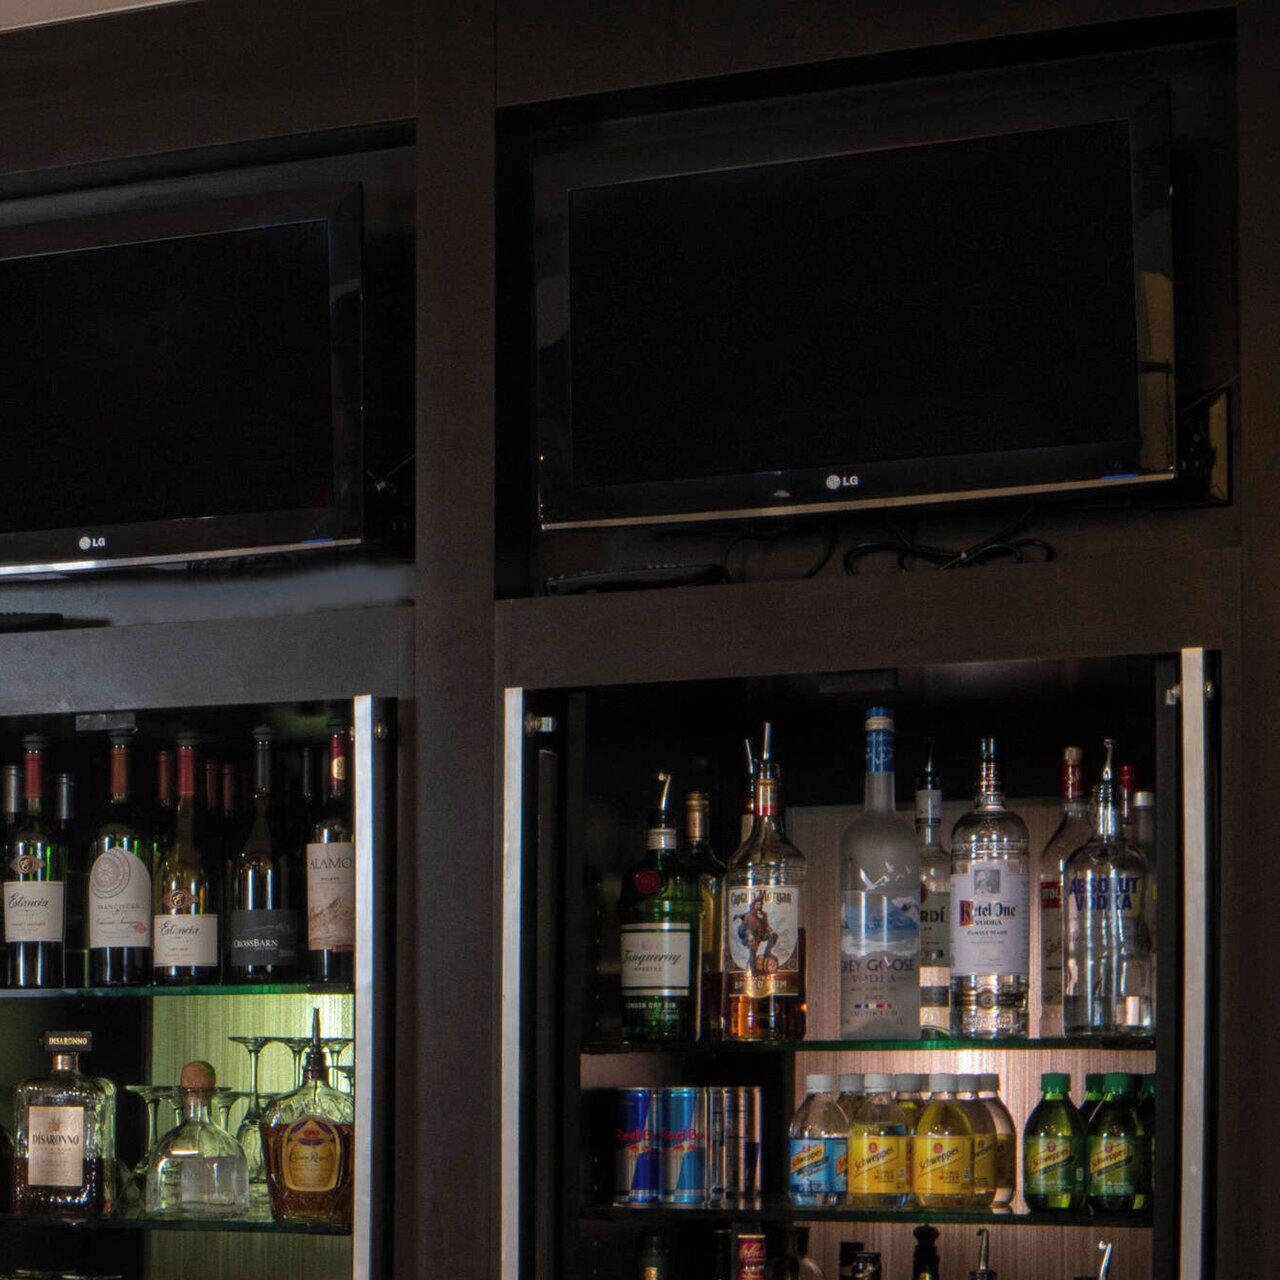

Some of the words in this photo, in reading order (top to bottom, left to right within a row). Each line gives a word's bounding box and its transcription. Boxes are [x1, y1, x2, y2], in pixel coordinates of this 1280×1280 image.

[843, 476, 859, 486] LG
[92, 537, 106, 547] LG
[311, 858, 353, 870] ALAMO
[48, 1037, 88, 1046] DISARONNO
[32, 1134, 80, 1146] DISARONNO
[853, 1147, 895, 1173] Schweppes
